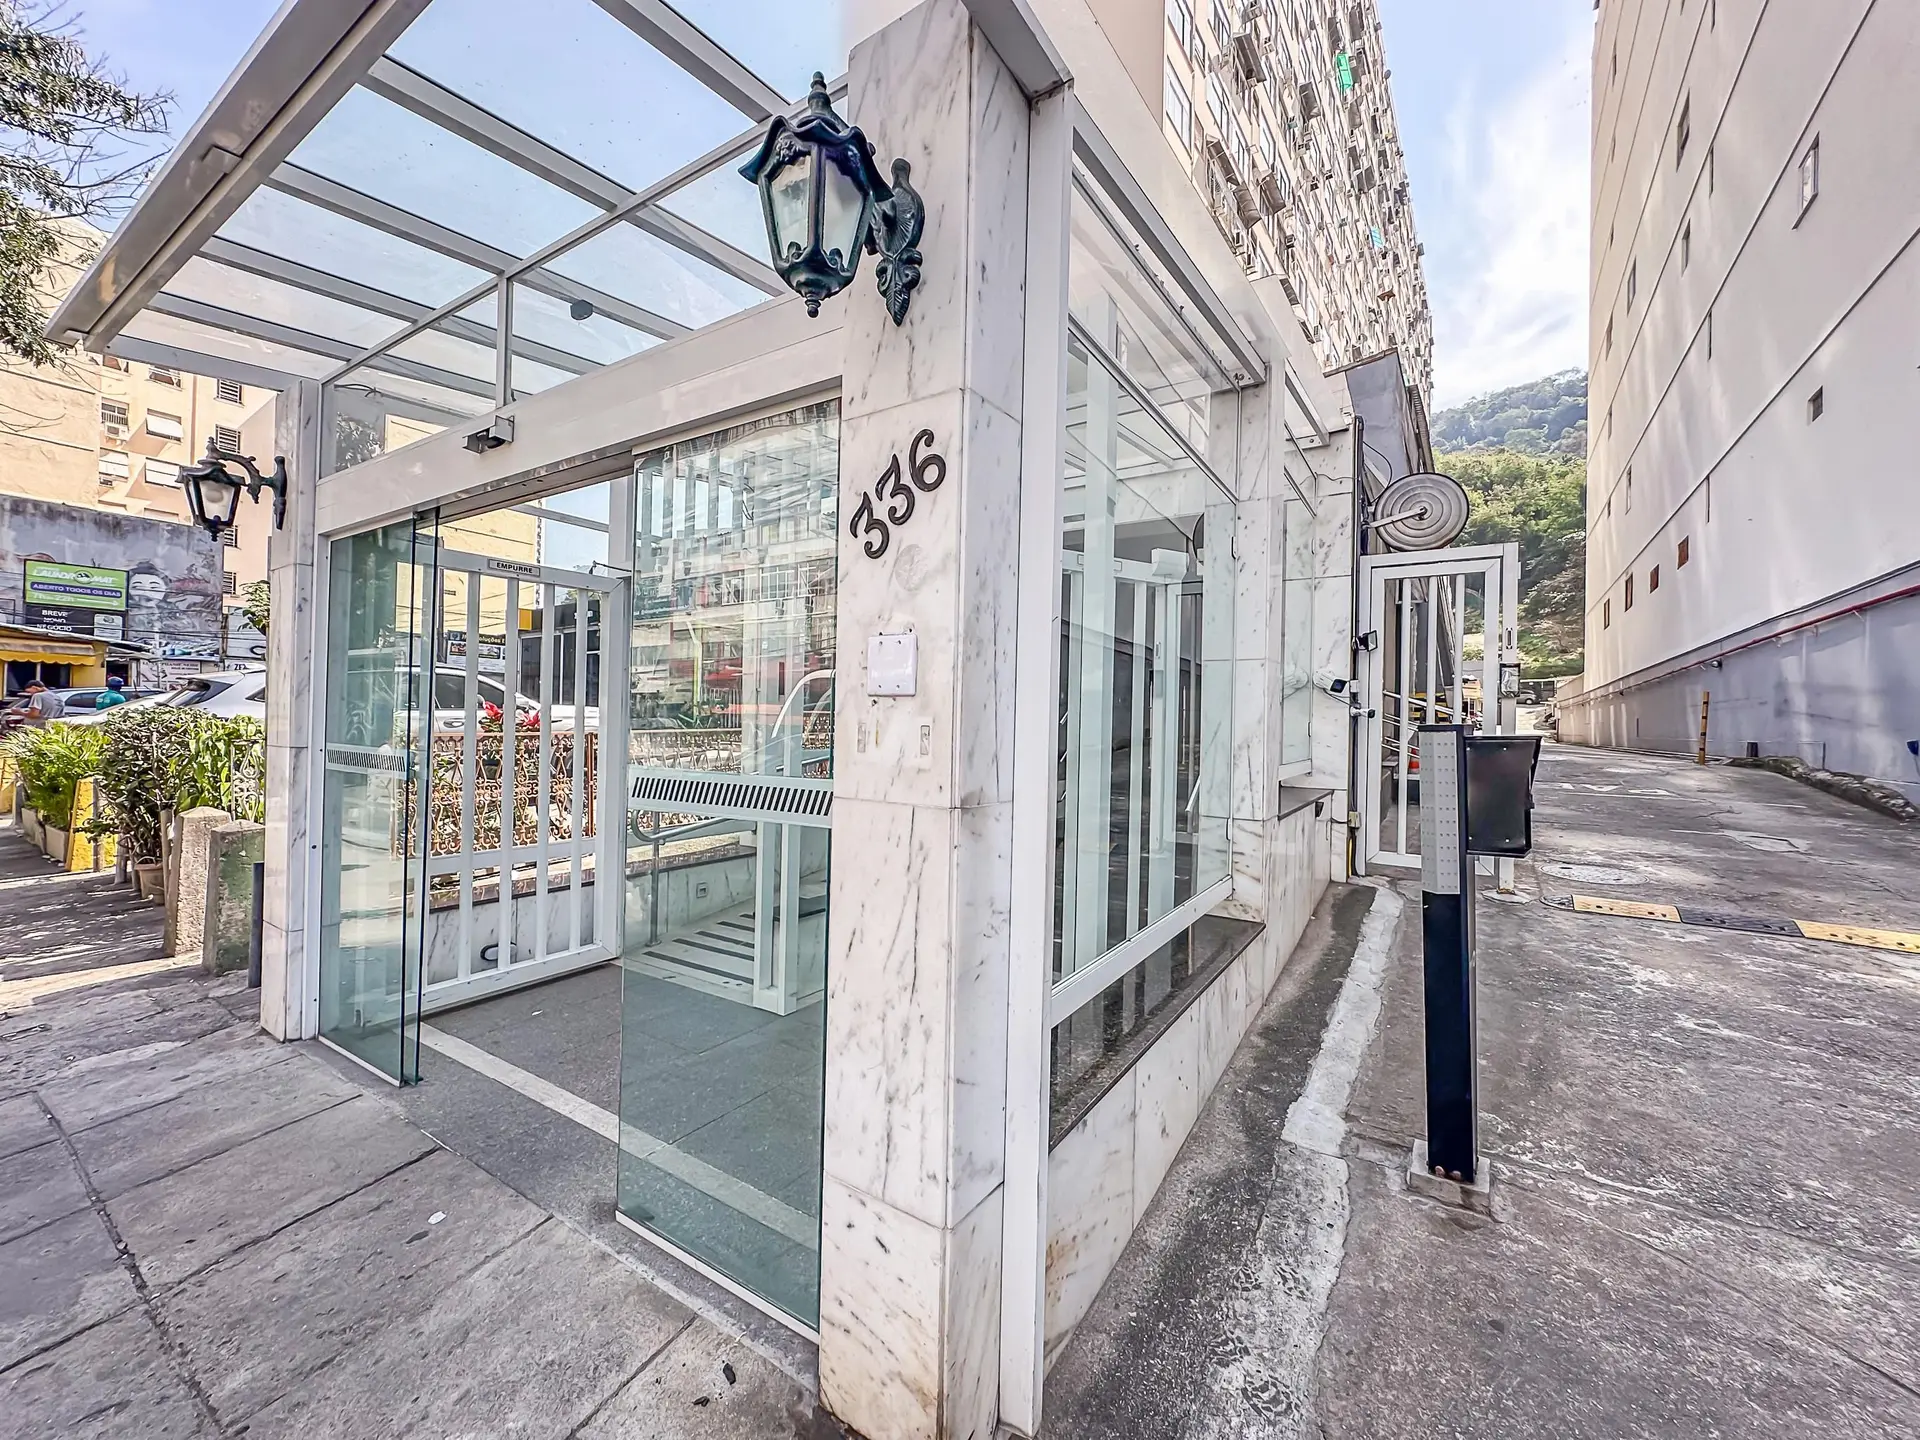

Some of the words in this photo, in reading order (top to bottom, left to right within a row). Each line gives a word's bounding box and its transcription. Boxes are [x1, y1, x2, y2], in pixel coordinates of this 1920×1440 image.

[849, 428, 947, 559] 336
[496, 562, 533, 573] EMPURRE
[33, 583, 64, 592] ABERTO
[66, 586, 91, 594] TODOS
[41, 609, 68, 617] BREVE
